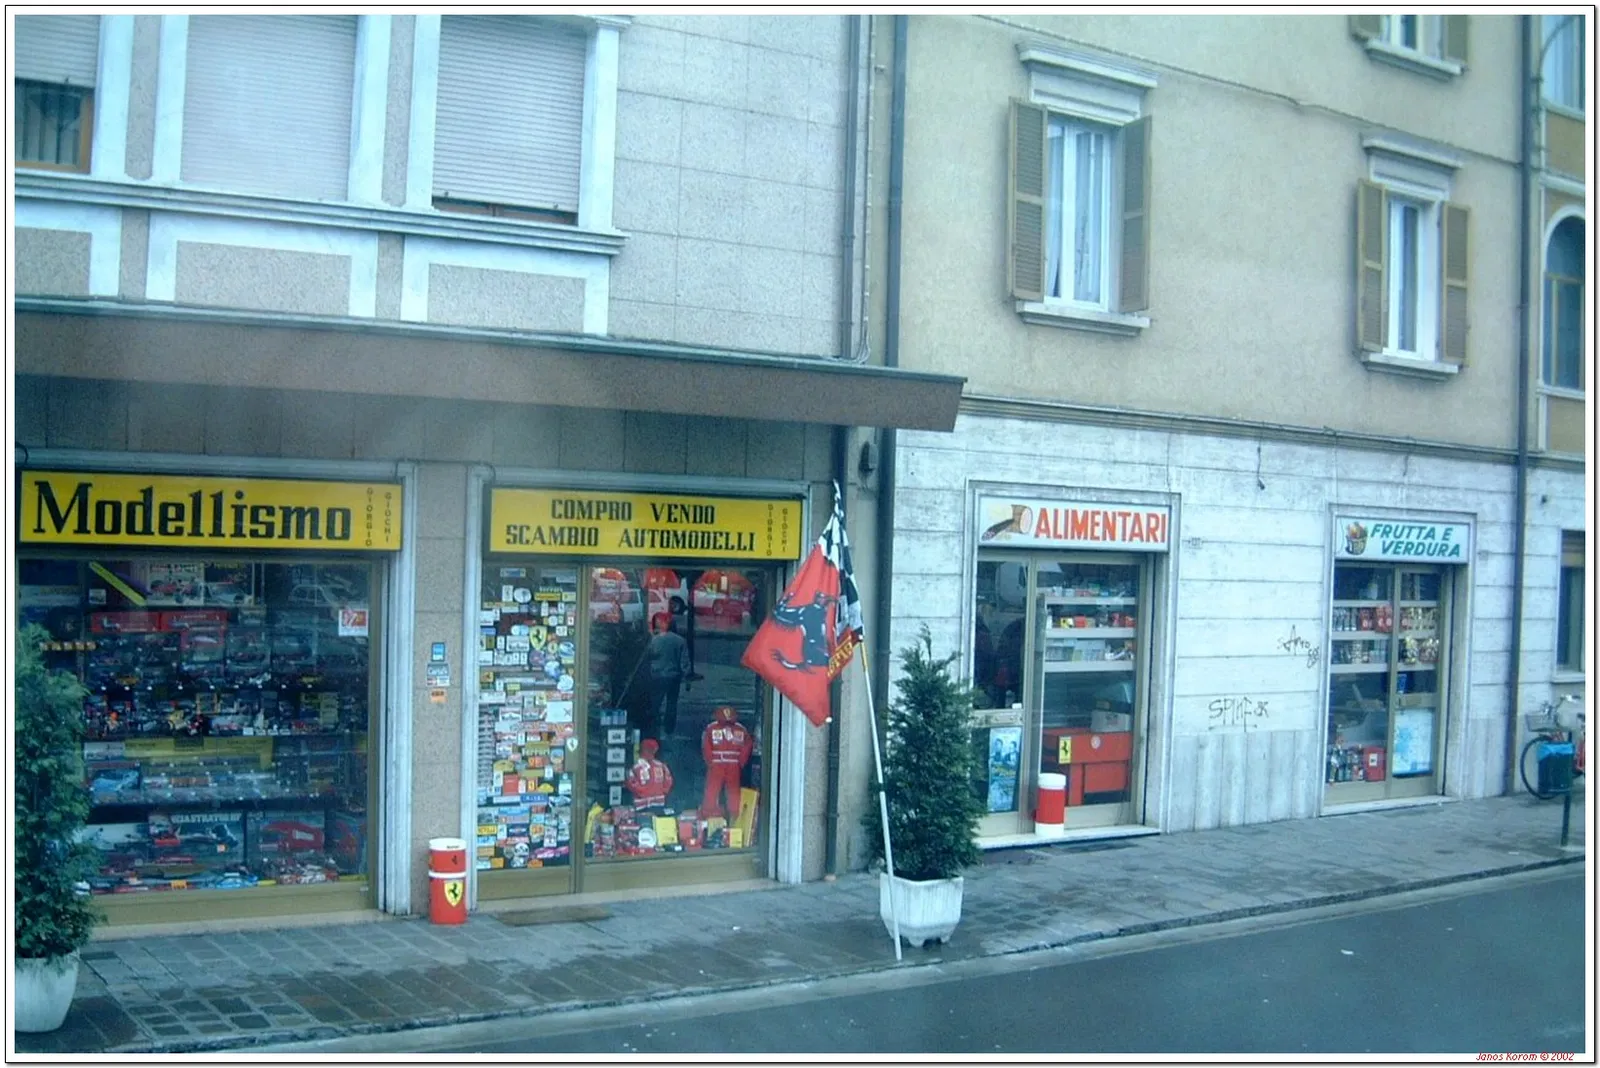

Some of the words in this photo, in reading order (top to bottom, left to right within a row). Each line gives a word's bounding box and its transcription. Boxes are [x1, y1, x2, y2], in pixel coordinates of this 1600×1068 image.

[33, 481, 351, 541] Modellismo
[365, 487, 374, 547] GIORGIO
[383, 492, 392, 543] GIOCHI
[551, 499, 632, 521] COMPRO
[650, 502, 715, 524] VENDO
[1034, 507, 1166, 544] ALIMENTARI
[506, 525, 599, 547] SCAMBIO
[618, 530, 756, 552] AUTOMODELLI
[1371, 523, 1437, 541] FRUTTA
[1441, 528, 1453, 541] E
[1381, 540, 1460, 558] VERDURA
